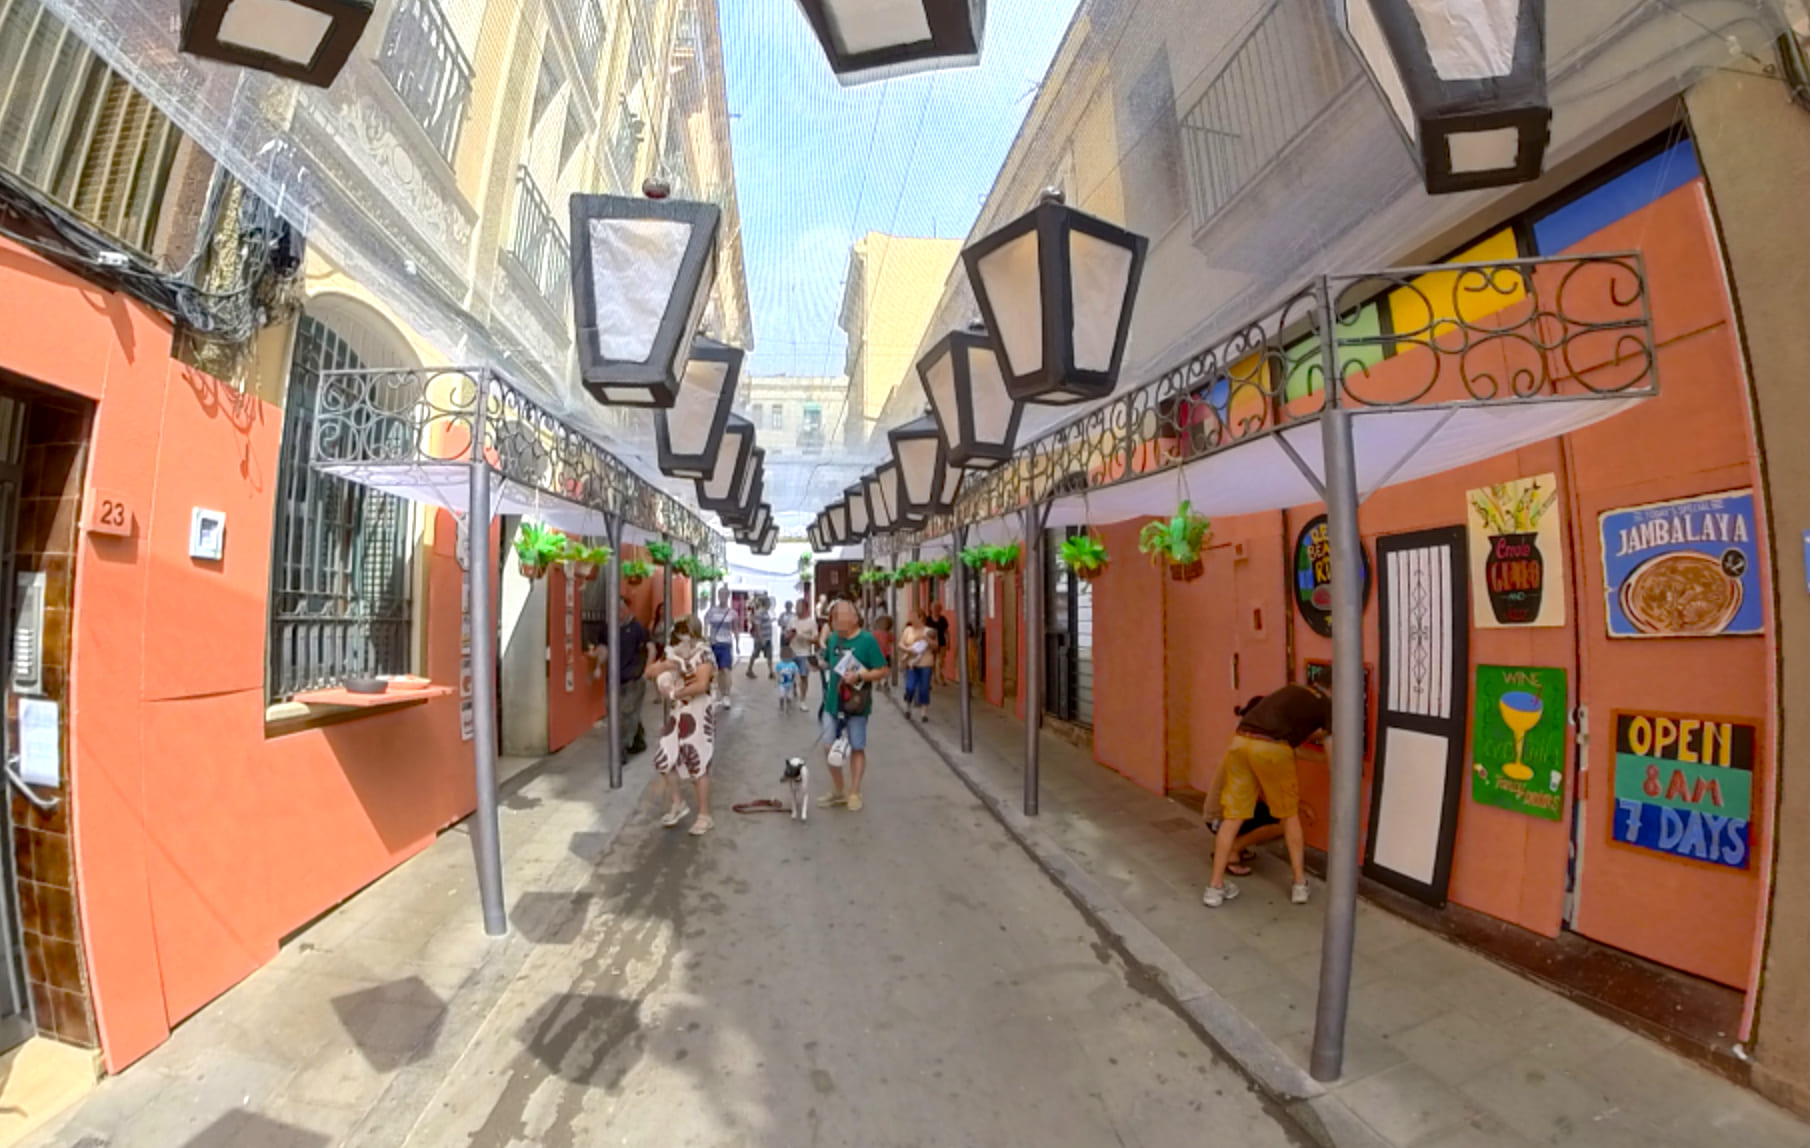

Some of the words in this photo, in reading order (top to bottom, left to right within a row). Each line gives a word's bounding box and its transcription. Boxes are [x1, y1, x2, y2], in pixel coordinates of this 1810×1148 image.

[101, 500, 125, 526] 23
[1310, 524, 1329, 542] RE
[1616, 513, 1749, 556] JAMBALAYA
[1502, 671, 1542, 687] WINE
[1628, 715, 1732, 768] OPEN
[1619, 797, 1643, 842] 7
[1658, 806, 1747, 865] DAYS
